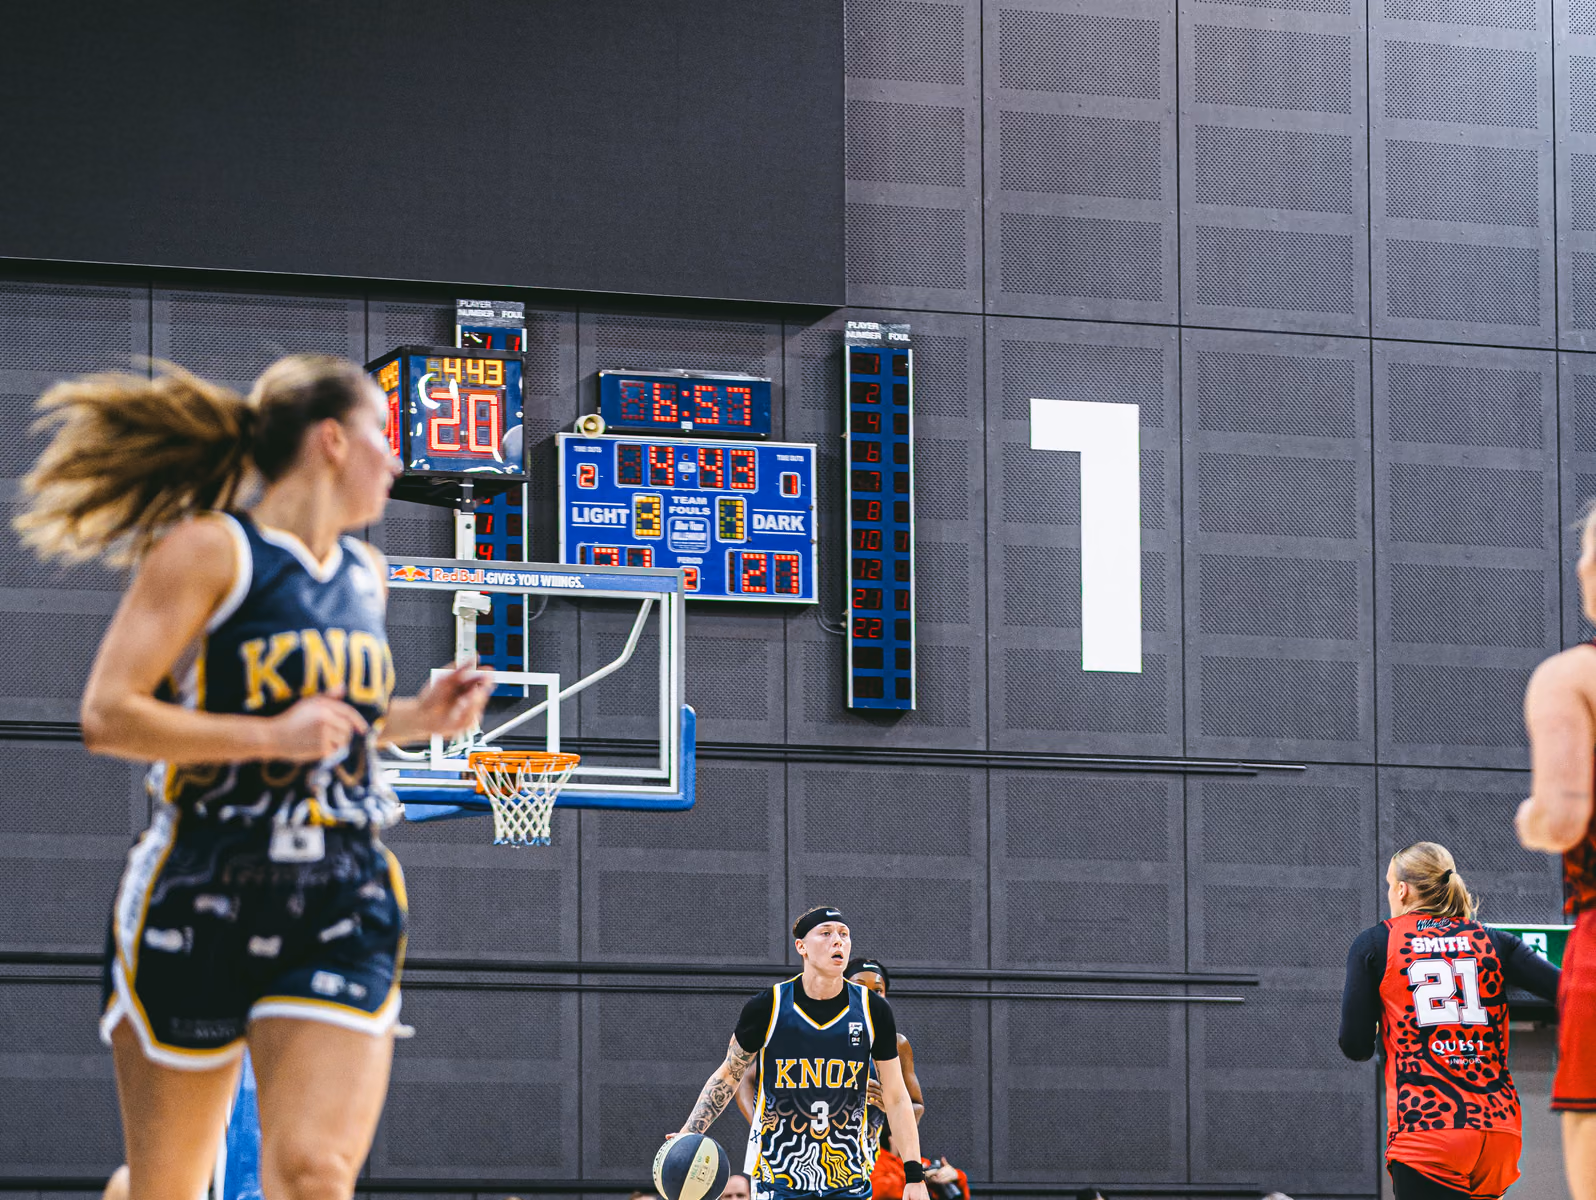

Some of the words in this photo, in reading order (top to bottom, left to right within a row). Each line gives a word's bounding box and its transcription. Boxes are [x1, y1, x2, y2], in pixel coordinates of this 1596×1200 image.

[430, 391, 500, 453] 20
[578, 464, 596, 488] 2
[668, 506, 711, 515] FOULS
[671, 496, 708, 505] TEAM
[571, 506, 630, 524] LIGHT
[752, 513, 806, 532] DARK
[1030, 398, 1142, 673] 1
[241, 628, 394, 709] KNO
[1411, 936, 1472, 954] SMITH
[1408, 957, 1489, 1027] 21
[1431, 1039, 1484, 1055] QUEST
[775, 1058, 864, 1090] KNOX
[811, 1101, 829, 1132] 3
